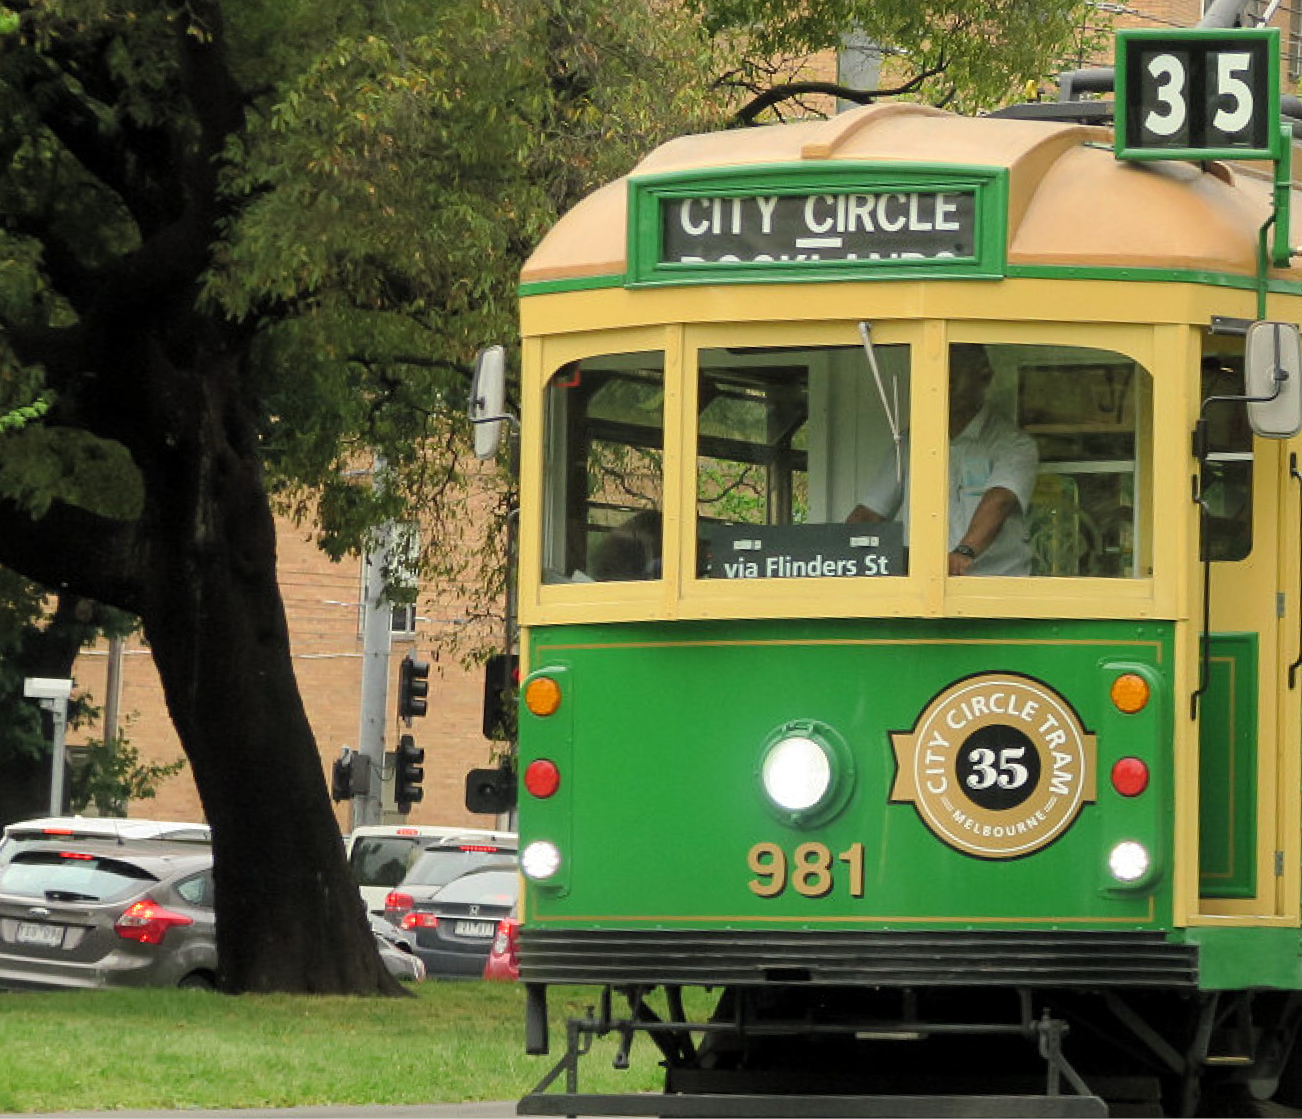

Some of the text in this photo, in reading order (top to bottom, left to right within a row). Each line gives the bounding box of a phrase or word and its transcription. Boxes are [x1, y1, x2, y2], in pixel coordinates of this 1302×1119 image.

[1145, 53, 1254, 136] 35
[680, 193, 960, 236] CITY CIRCLE
[724, 553, 889, 578] via Flinders St
[925, 693, 1074, 796] CITY CIRCLE TRAM
[966, 747, 1029, 790] 35
[952, 810, 1047, 837] MELBOURNE
[747, 842, 865, 899] 981
